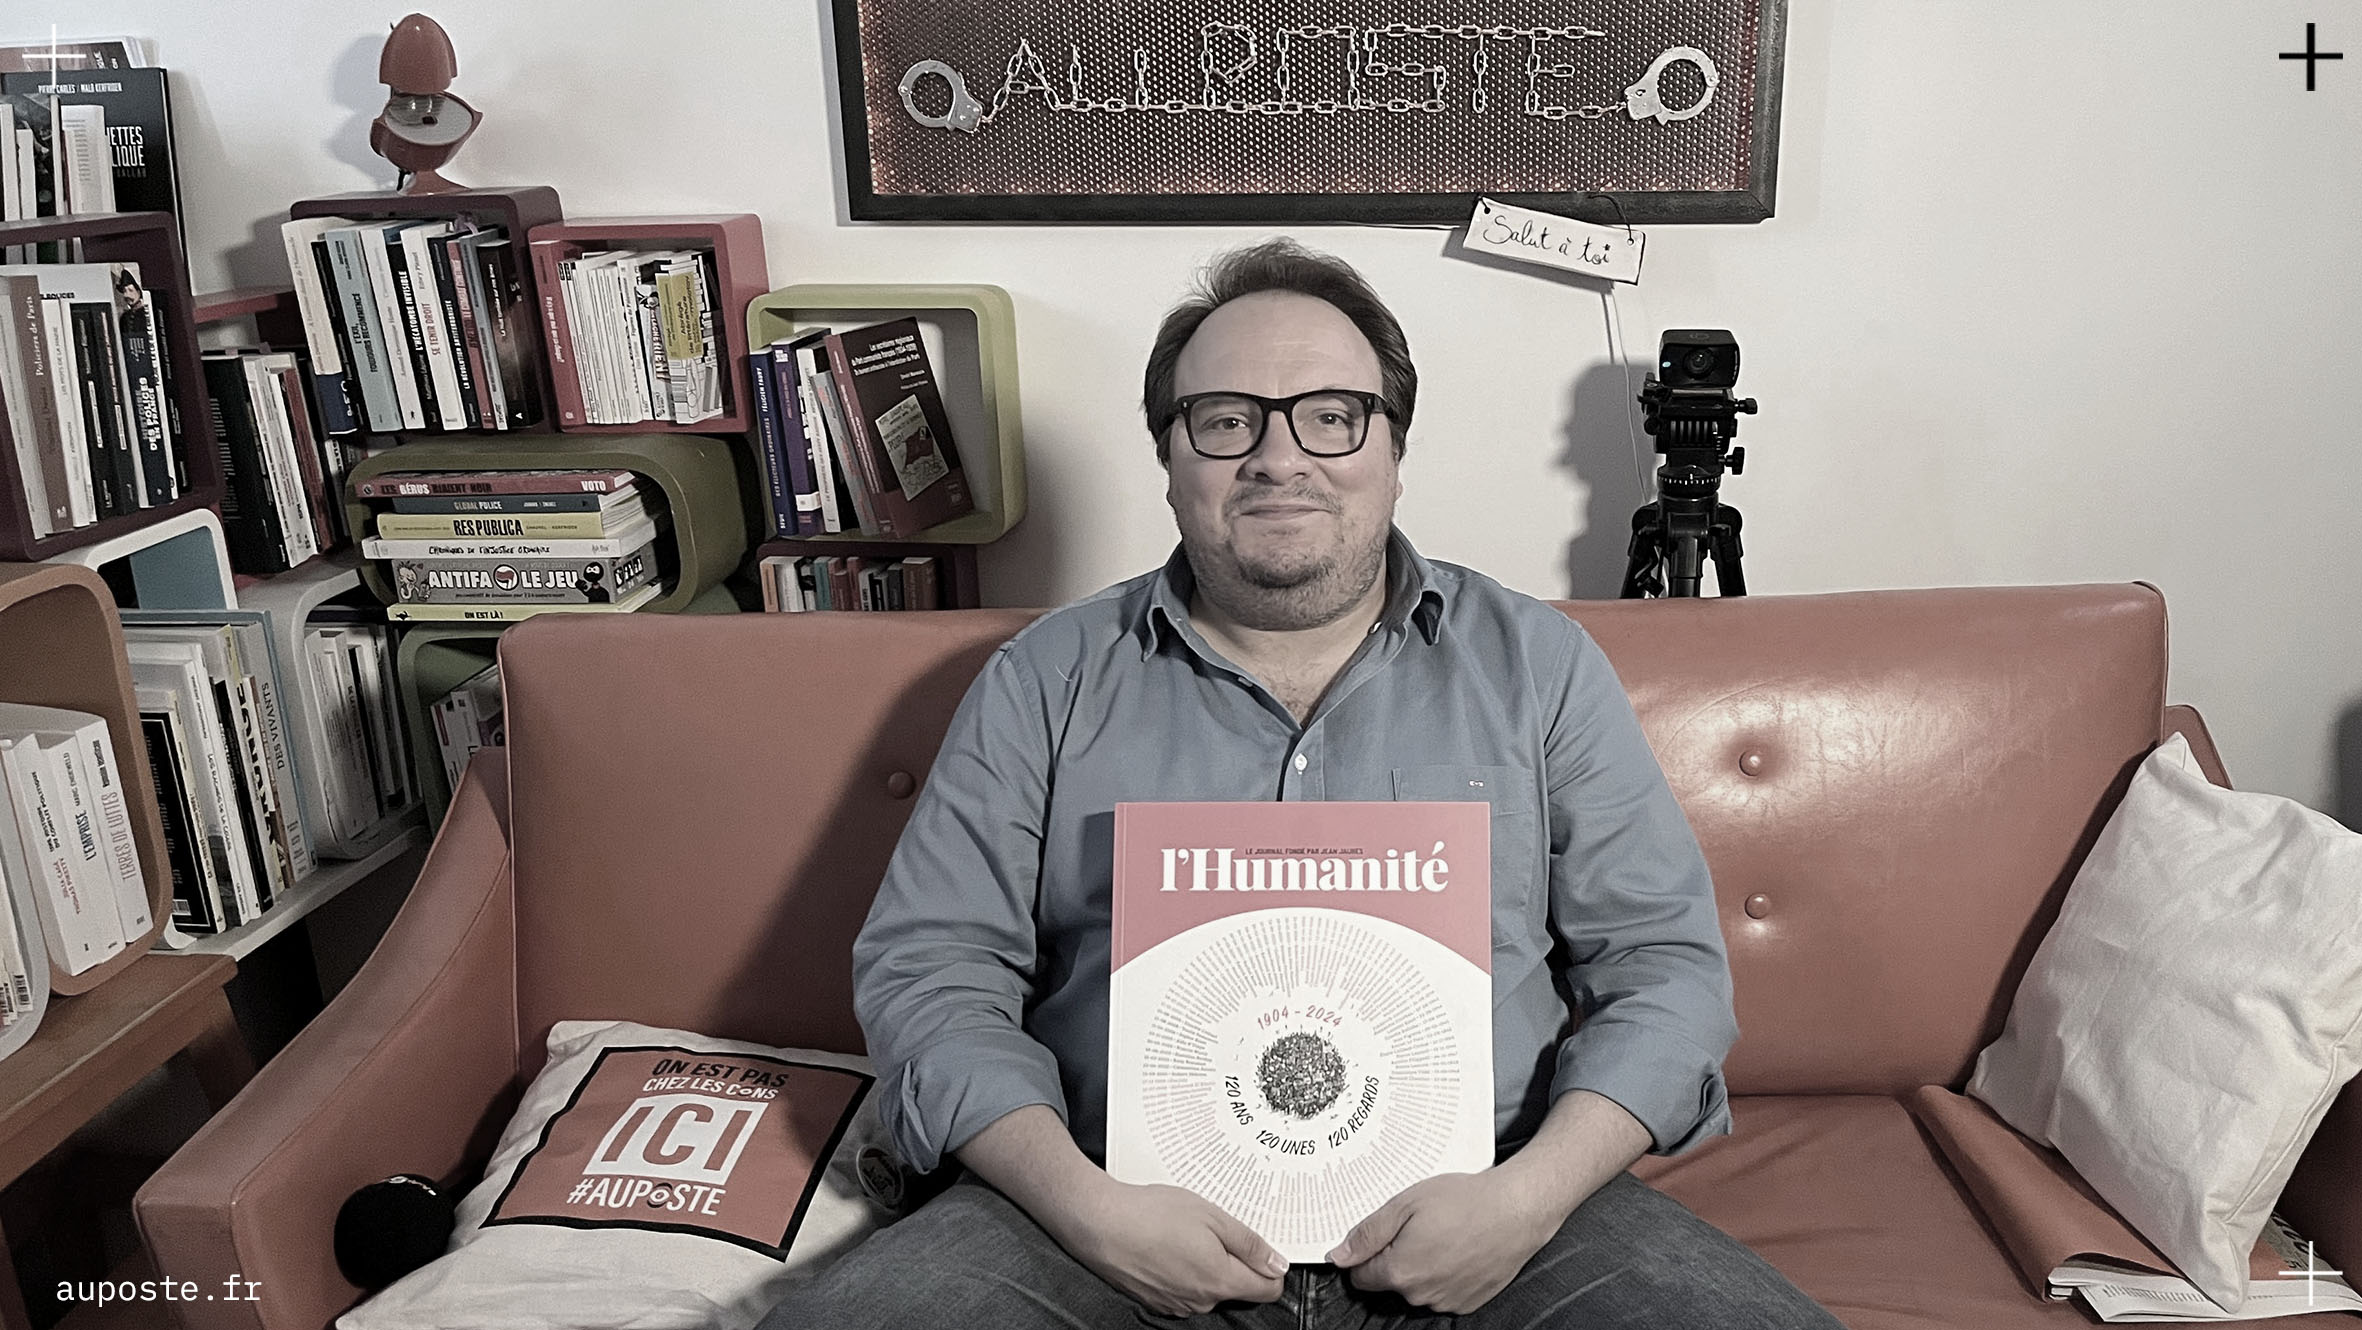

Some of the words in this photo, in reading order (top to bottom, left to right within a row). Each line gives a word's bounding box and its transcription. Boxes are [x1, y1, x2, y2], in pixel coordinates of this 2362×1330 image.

[1483, 214, 1552, 250] Salut
[1558, 236, 1570, 256] à
[1578, 236, 1610, 265] toi
[399, 269, 412, 305] INVISIBLE
[25, 295, 36, 319] Paris
[422, 301, 433, 324] DROIT
[676, 300, 686, 334] Abrégé
[29, 322, 37, 334] de
[407, 305, 422, 351] L'HÉCATOMBE
[427, 324, 438, 346] TENIR
[431, 346, 440, 355] SE
[139, 376, 154, 425] POLICES
[149, 386, 158, 423] FRANCE
[148, 427, 158, 450] DES
[155, 425, 161, 438] EN
[399, 482, 430, 495] BÉRUS
[581, 480, 606, 491] VOTO
[479, 501, 502, 510] POLICE
[453, 519, 475, 536] RES
[476, 519, 524, 536] PUBLICA
[429, 571, 493, 588] ANTIFA
[521, 571, 545, 588] LE
[545, 571, 578, 588] JEU
[261, 682, 279, 742] VIVANTS
[273, 742, 284, 769] DES
[32, 770, 46, 808] POLITIQUE
[72, 787, 81, 806] MARC
[44, 807, 56, 837] CONFLIT
[102, 790, 123, 829] LUTTES
[53, 837, 60, 848] DU
[76, 809, 96, 860] L'EMPRISE
[110, 827, 128, 843] DE
[116, 841, 137, 880] TERRES
[1285, 846, 1305, 855] FONDÉ
[1160, 840, 1449, 892] l'Humanité
[69, 885, 81, 914] THOMAS
[1258, 1006, 1289, 1030] 1904
[1306, 1004, 1343, 1028] 2024
[642, 1077, 691, 1092] CHEZ
[690, 1078, 725, 1093] LES
[652, 1059, 690, 1076] ON
[690, 1062, 740, 1079] EST
[740, 1068, 789, 1088] PAS
[1225, 1075, 1241, 1098] 120
[1230, 1101, 1254, 1126] ANS
[1348, 1075, 1380, 1133] REGARDS
[600, 1102, 753, 1172] ICI
[1256, 1130, 1280, 1149] 120
[1280, 1140, 1316, 1155] UNES
[1328, 1127, 1349, 1149] 120
[566, 1178, 726, 1216] #AUPOSTE
